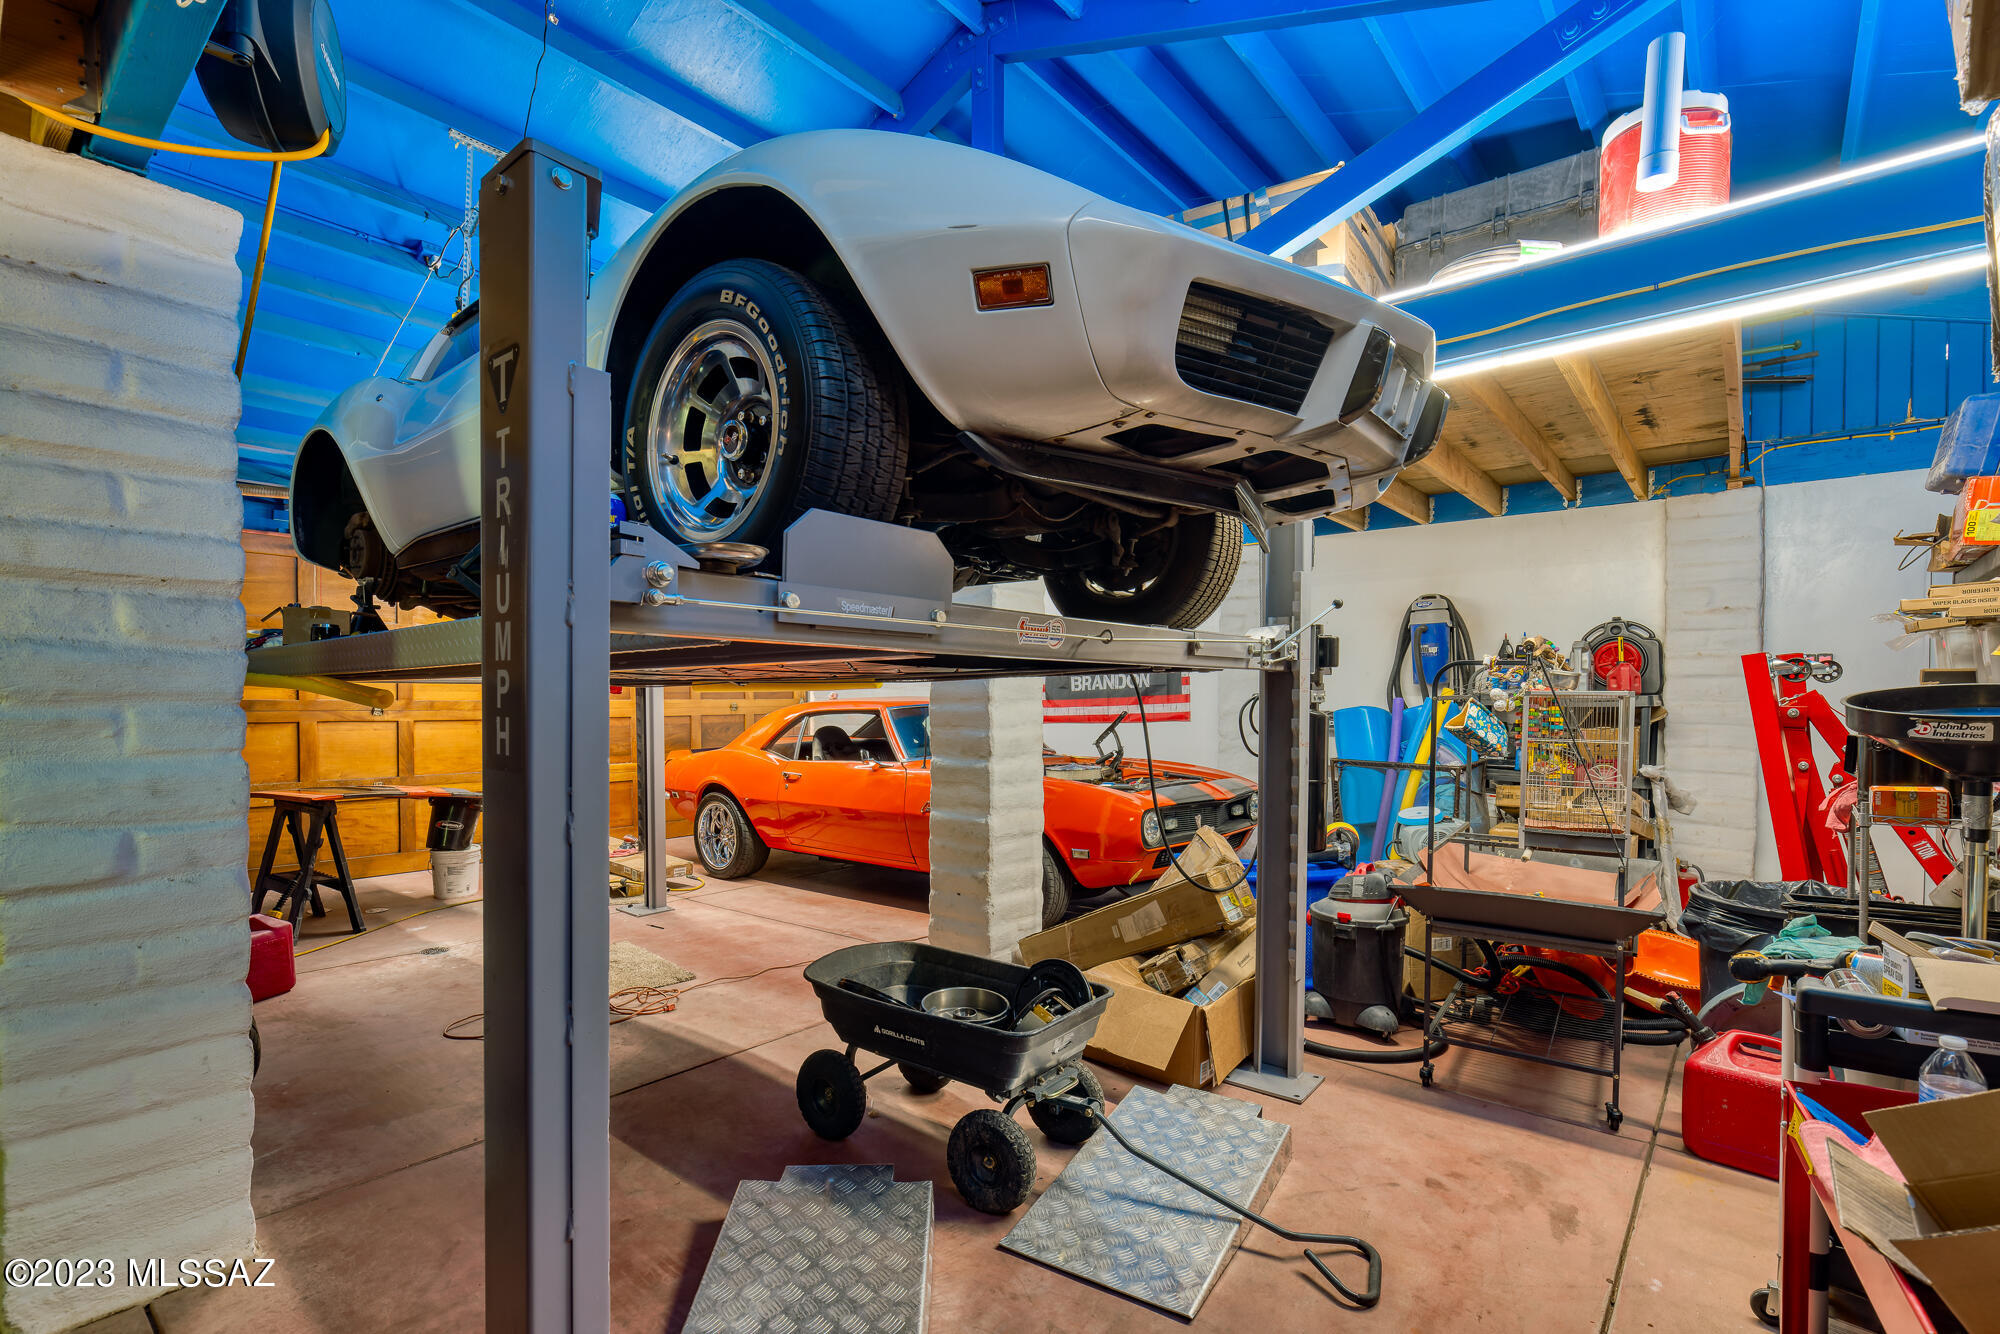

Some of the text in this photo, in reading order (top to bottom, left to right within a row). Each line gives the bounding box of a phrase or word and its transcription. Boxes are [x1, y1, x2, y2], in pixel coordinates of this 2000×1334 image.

[720, 289, 790, 456] BFGoodrich
[1966, 521, 1977, 536] 100
[495, 426, 512, 757] TRIUMPH
[1071, 673, 1150, 692] BRANDON
[1932, 721, 1986, 731] JohnDow
[1932, 729, 1985, 739] Industries
[881, 1028, 925, 1046] GORILLA CARTS
